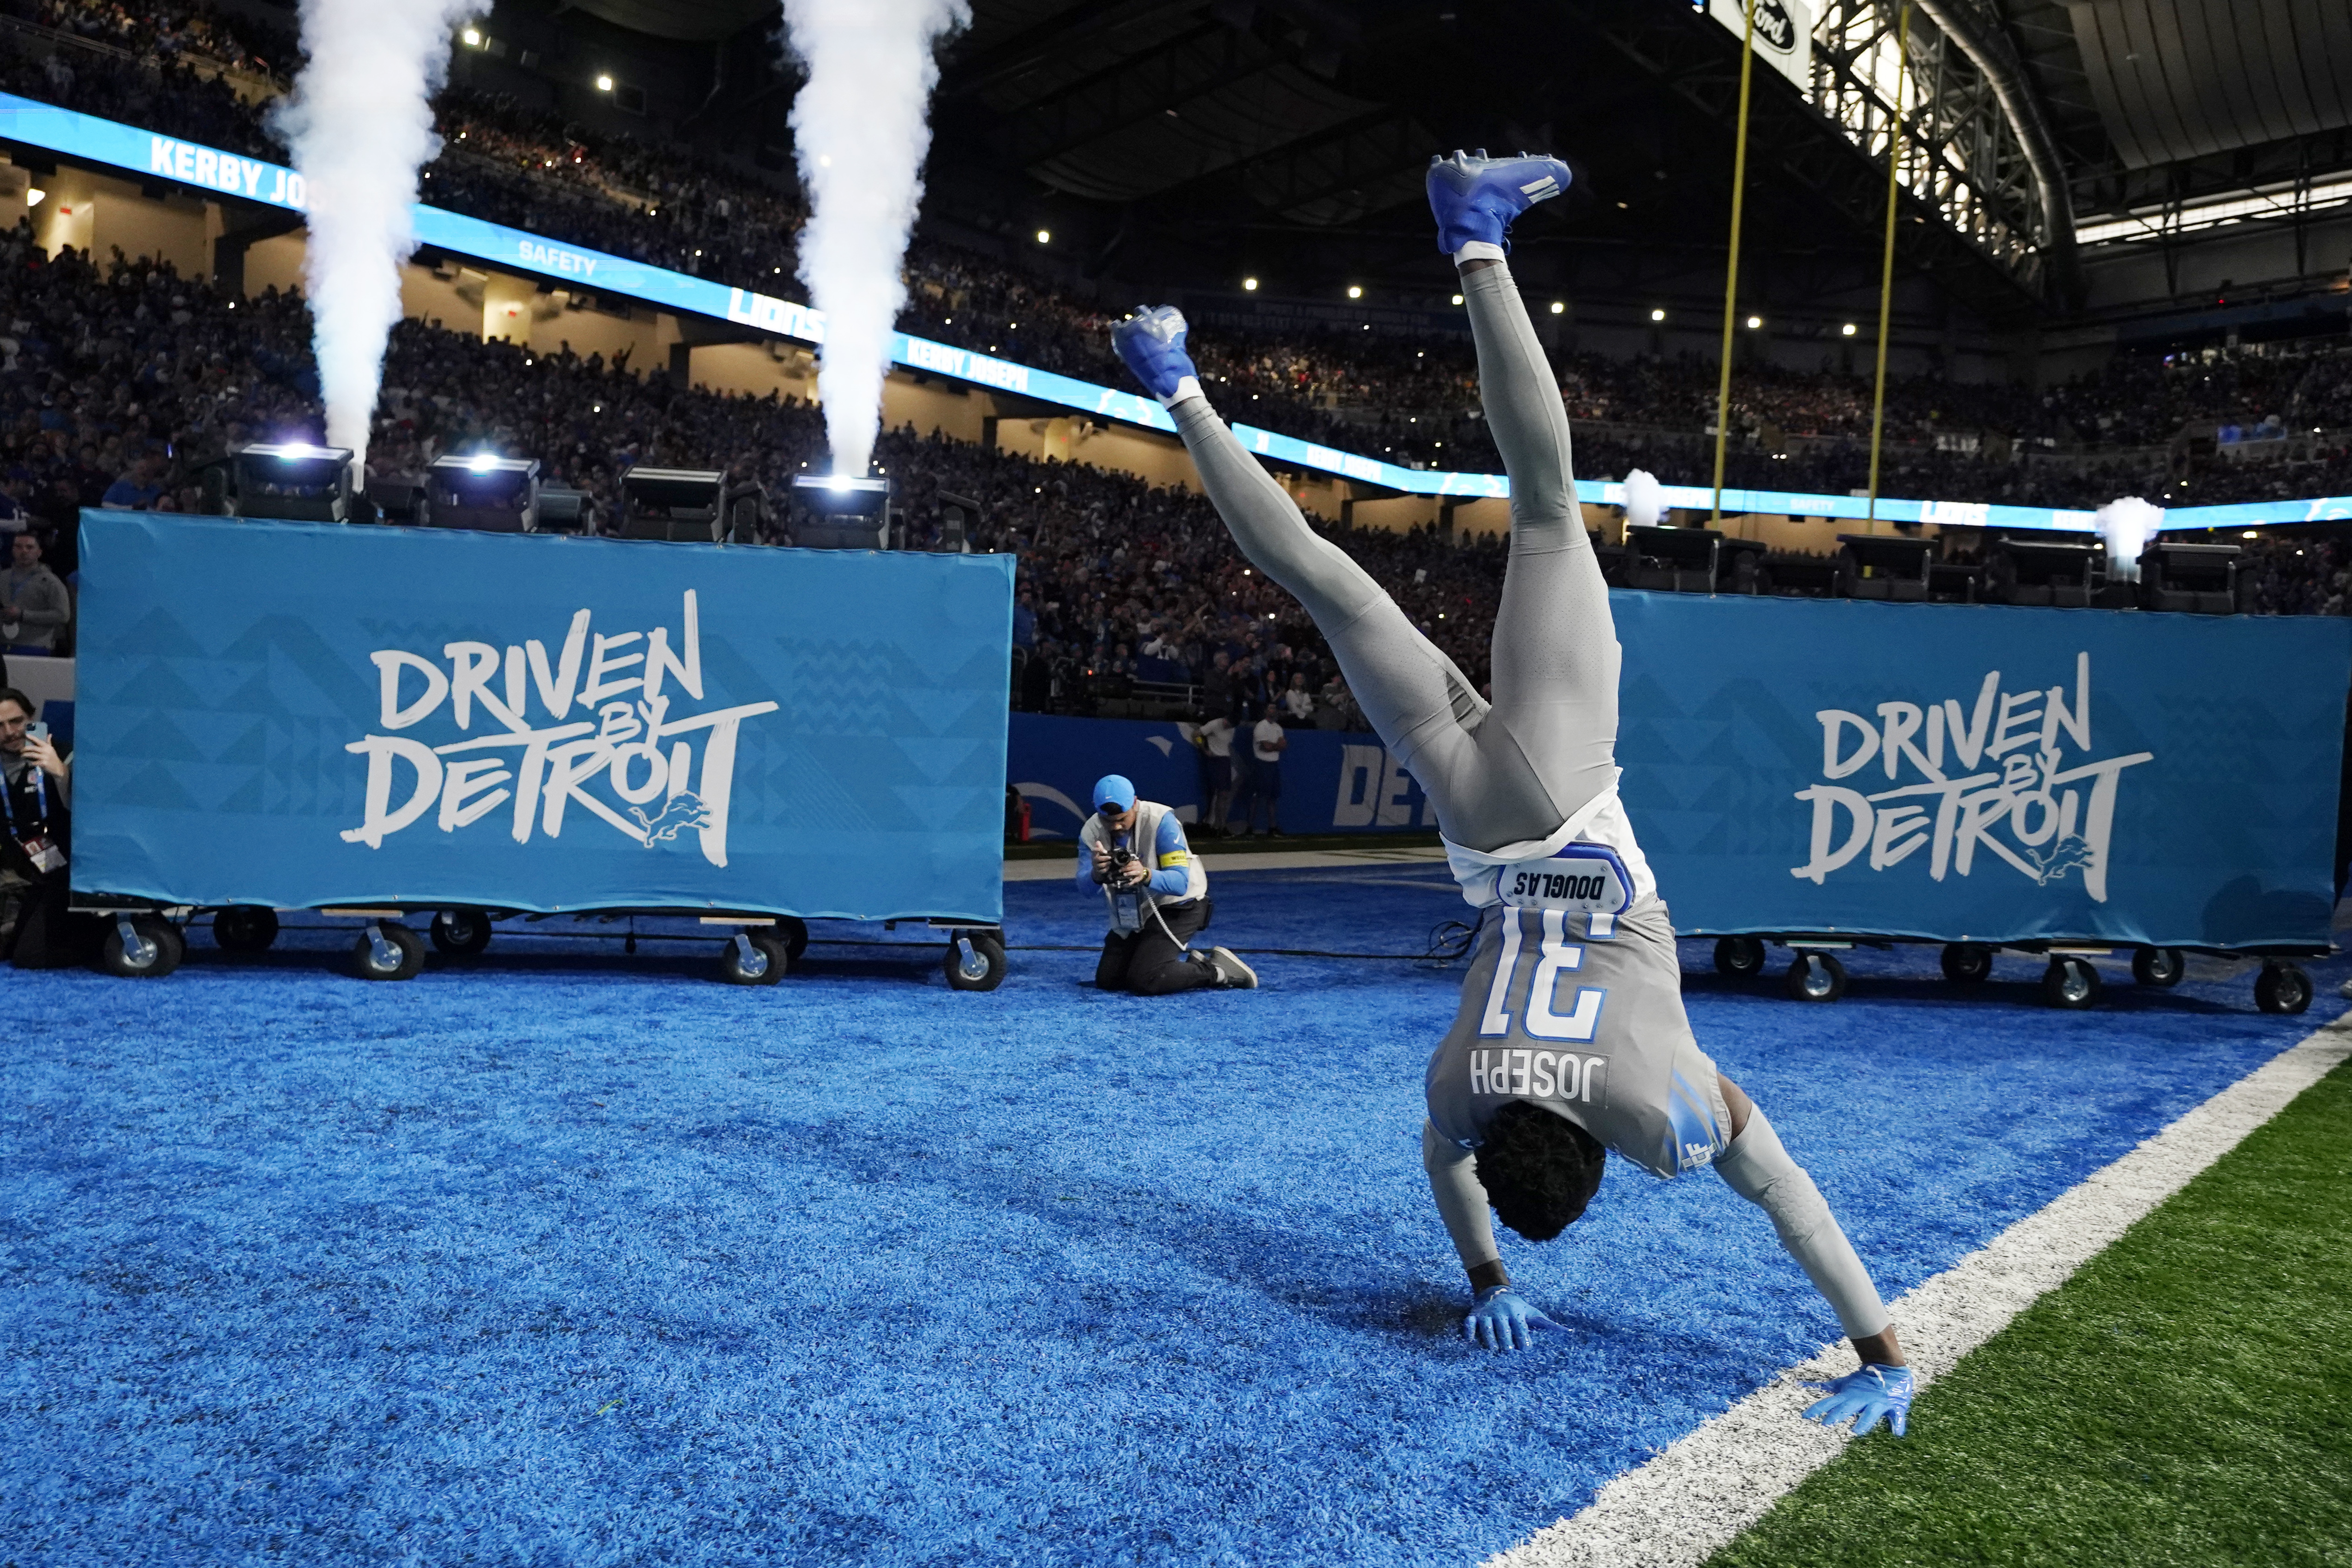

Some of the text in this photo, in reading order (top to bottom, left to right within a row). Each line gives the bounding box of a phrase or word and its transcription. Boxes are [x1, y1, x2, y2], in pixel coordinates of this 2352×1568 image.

[151, 136, 263, 197] KERBY
[519, 239, 597, 277] SAFETY
[726, 287, 827, 344] LIONS
[907, 337, 1029, 392] KERBY JOSEPH
[1306, 444, 1382, 483] KERBY JOSEPH
[1790, 498, 1835, 512] SAFETY
[370, 588, 703, 731] DRIVEN
[595, 695, 670, 759] BY
[1816, 651, 2091, 783] DRIVEN
[340, 701, 780, 868] DETROIT
[1332, 744, 1439, 826] DE
[2003, 747, 2062, 804] BY
[1790, 752, 2154, 903] DETROIT
[1514, 871, 1606, 901] DOUGLAS
[1477, 905, 1617, 1044] 31
[1470, 1049, 1604, 1103] JOSEPH
